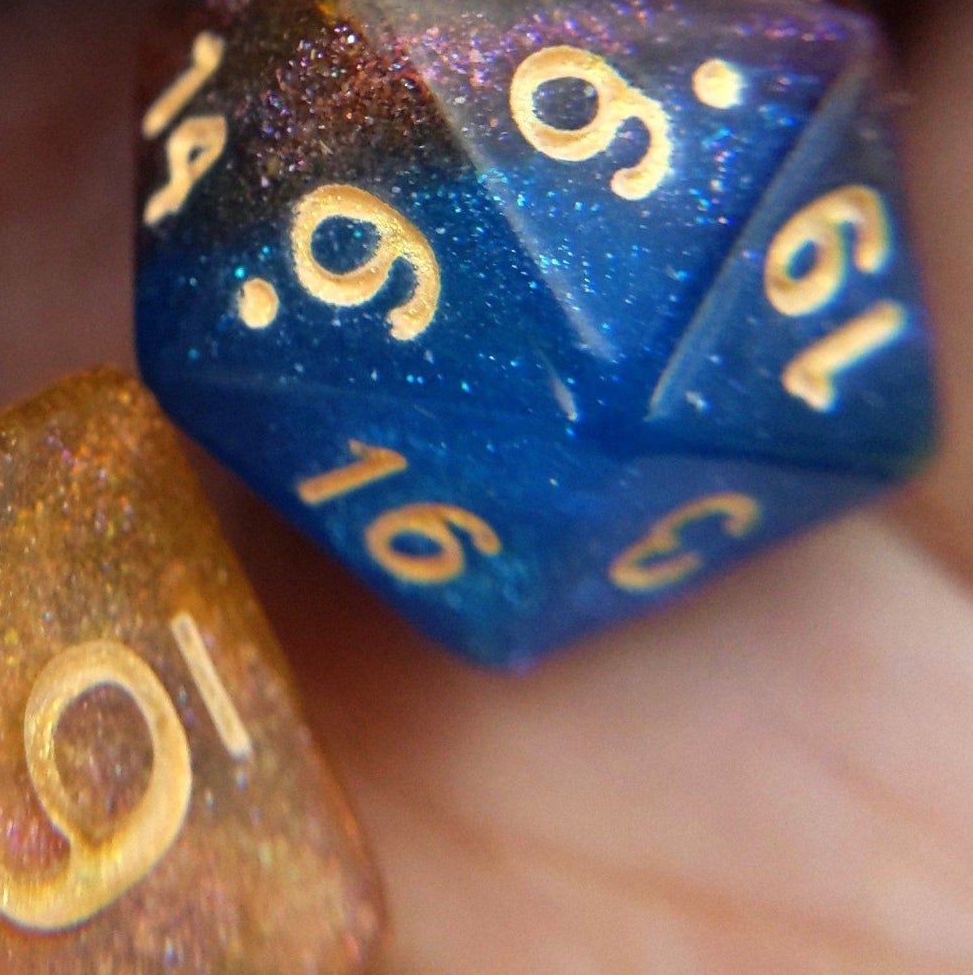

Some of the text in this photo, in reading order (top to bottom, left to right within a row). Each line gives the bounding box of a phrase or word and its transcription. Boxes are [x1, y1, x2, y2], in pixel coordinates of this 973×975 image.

[142, 30, 227, 225] 14
[764, 185, 910, 412] 19
[297, 437, 502, 585] 16
[610, 492, 763, 591] 3
